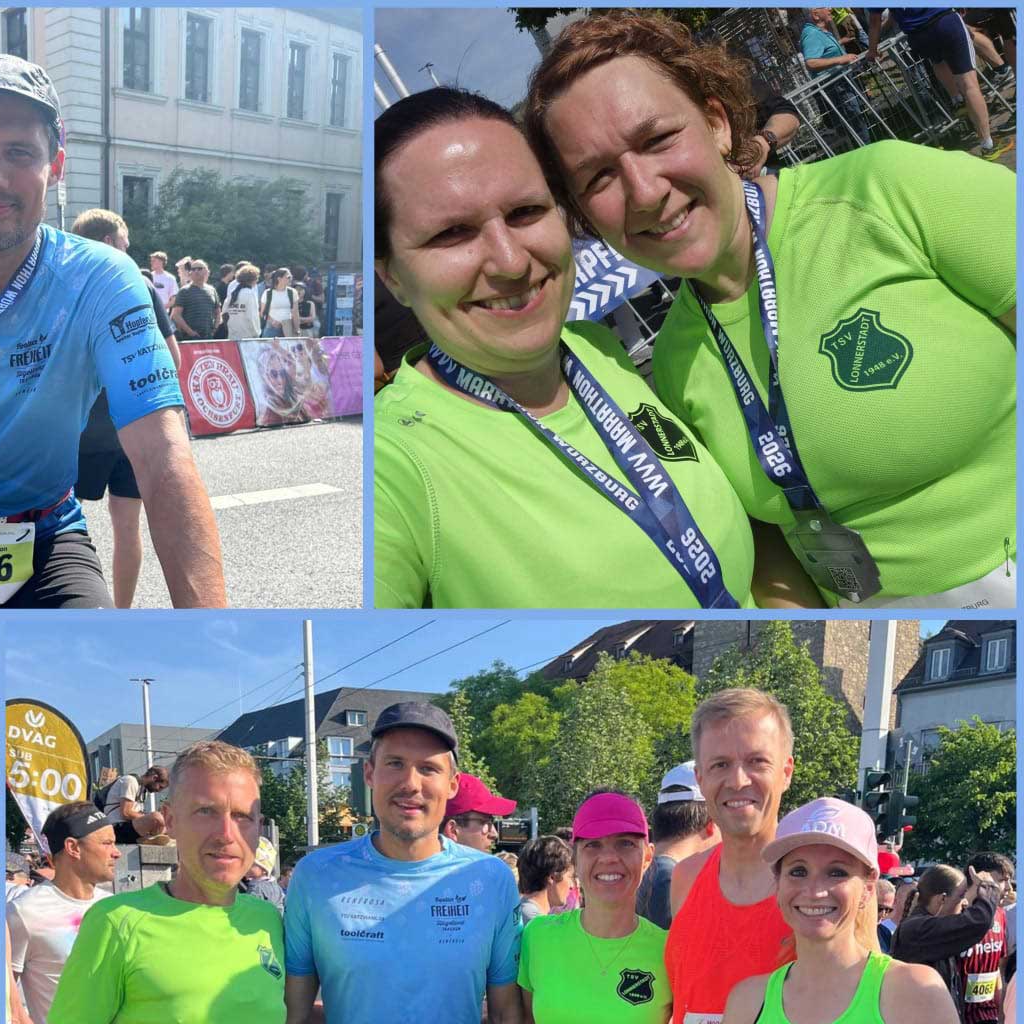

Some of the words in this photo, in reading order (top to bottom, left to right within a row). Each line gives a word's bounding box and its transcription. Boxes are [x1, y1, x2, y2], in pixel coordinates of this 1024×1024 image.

[831, 331, 852, 350] TSV
[849, 316, 871, 383] LONNERSTADT
[864, 361, 886, 376] 1948
[572, 369, 637, 455] MARATHON
[628, 451, 669, 499] WVV
[759, 431, 792, 479] 2026
[681, 527, 716, 584] 2026
[8, 725, 57, 748] DVAG
[8, 760, 82, 801] 5:00
[431, 904, 470, 917] FREIHEIT
